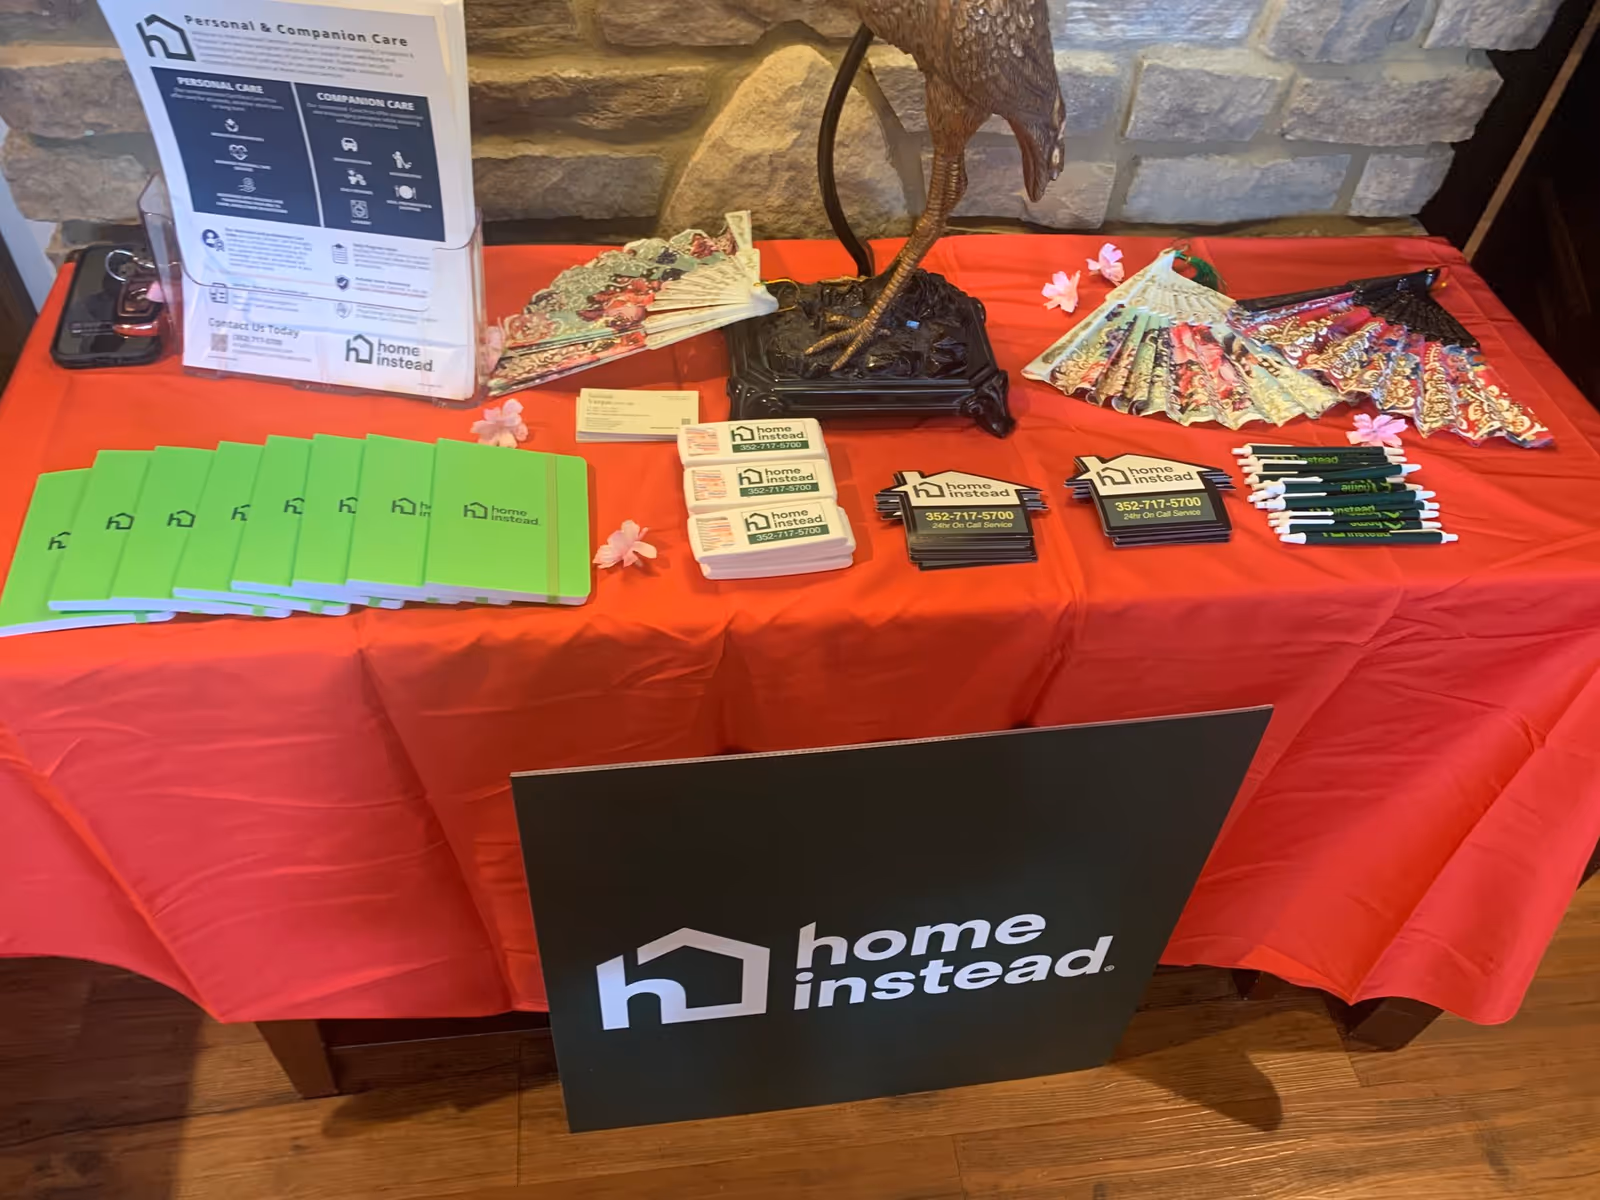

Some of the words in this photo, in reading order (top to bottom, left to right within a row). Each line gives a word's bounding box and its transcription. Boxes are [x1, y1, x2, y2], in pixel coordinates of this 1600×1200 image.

[184, 15, 256, 31] Personal
[260, 22, 272, 33] &
[277, 24, 367, 43] Companion
[372, 34, 408, 47] Care
[176, 76, 235, 91] PERSONAL
[235, 83, 264, 94] CARE
[316, 92, 386, 108] COMPANION
[386, 100, 415, 111] CARE
[208, 317, 249, 331] Contact
[252, 323, 265, 333] Us
[268, 324, 300, 338] Today
[377, 339, 420, 356] home
[757, 424, 792, 433] home
[758, 430, 806, 441] instead
[740, 441, 802, 452] 352-717-5700
[765, 466, 801, 476] home
[1128, 464, 1174, 475] home
[766, 473, 815, 484] instead
[1131, 471, 1194, 484] instead
[748, 484, 812, 496] 352-717-5700
[946, 482, 992, 491] home
[948, 488, 1011, 499] instead
[1114, 496, 1202, 512] 352-717-5700
[491, 505, 528, 516] home
[771, 508, 809, 520] home
[925, 510, 1014, 521] 352-717-5700
[1123, 512, 1142, 521] 24hr
[1143, 512, 1156, 520] On
[1156, 510, 1172, 519] Call
[1172, 508, 1202, 518] Service
[491, 514, 540, 526] instead
[773, 513, 824, 529] instead
[932, 522, 951, 530] 24hr
[952, 522, 965, 530] On
[966, 521, 982, 530] Call
[982, 520, 1013, 530] Service
[756, 527, 822, 542] 352-717-5700
[795, 912, 1047, 970] home
